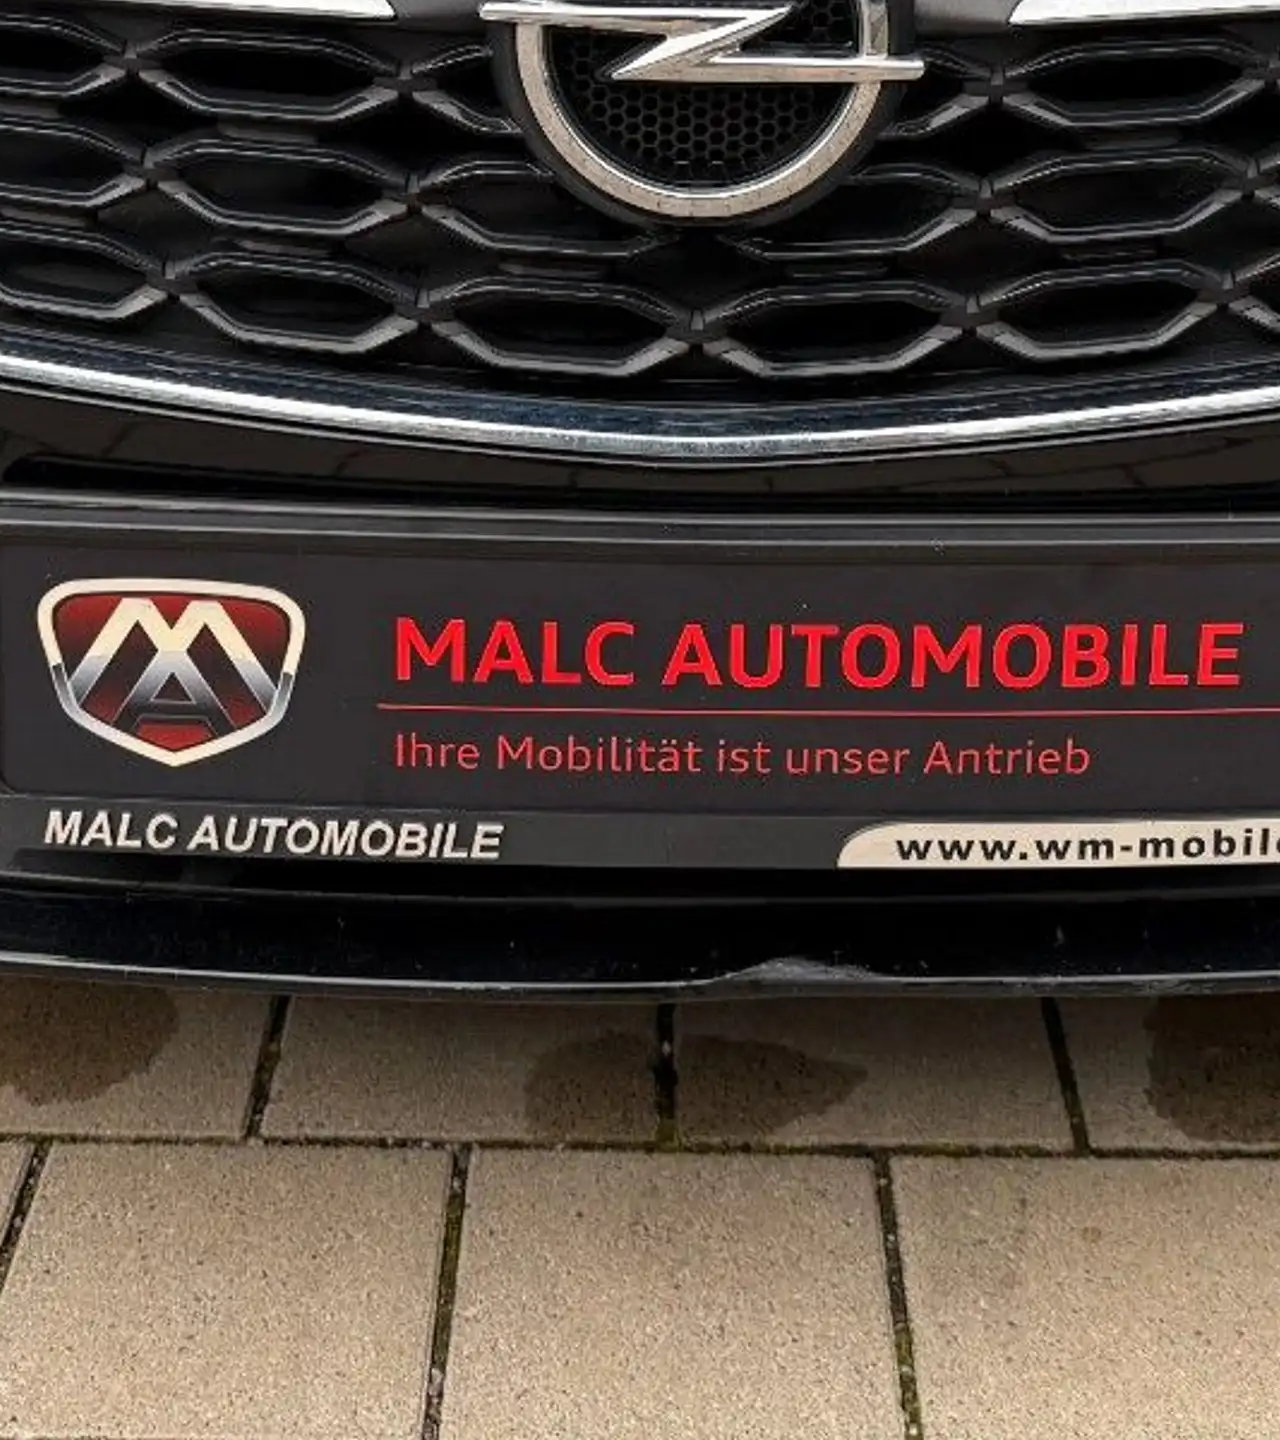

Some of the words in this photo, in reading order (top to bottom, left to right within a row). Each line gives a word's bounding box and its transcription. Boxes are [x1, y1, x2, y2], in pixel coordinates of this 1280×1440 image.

[393, 616, 637, 686] MALC
[661, 622, 1247, 692] AUTOMOBILE
[394, 732, 480, 769] Ihre
[496, 733, 702, 774] Mobilität
[716, 739, 772, 774] ist
[784, 743, 910, 776] unser
[923, 740, 1091, 778] Antrieb
[43, 809, 179, 851] MALC
[186, 814, 505, 859] AUTOMOBILE
